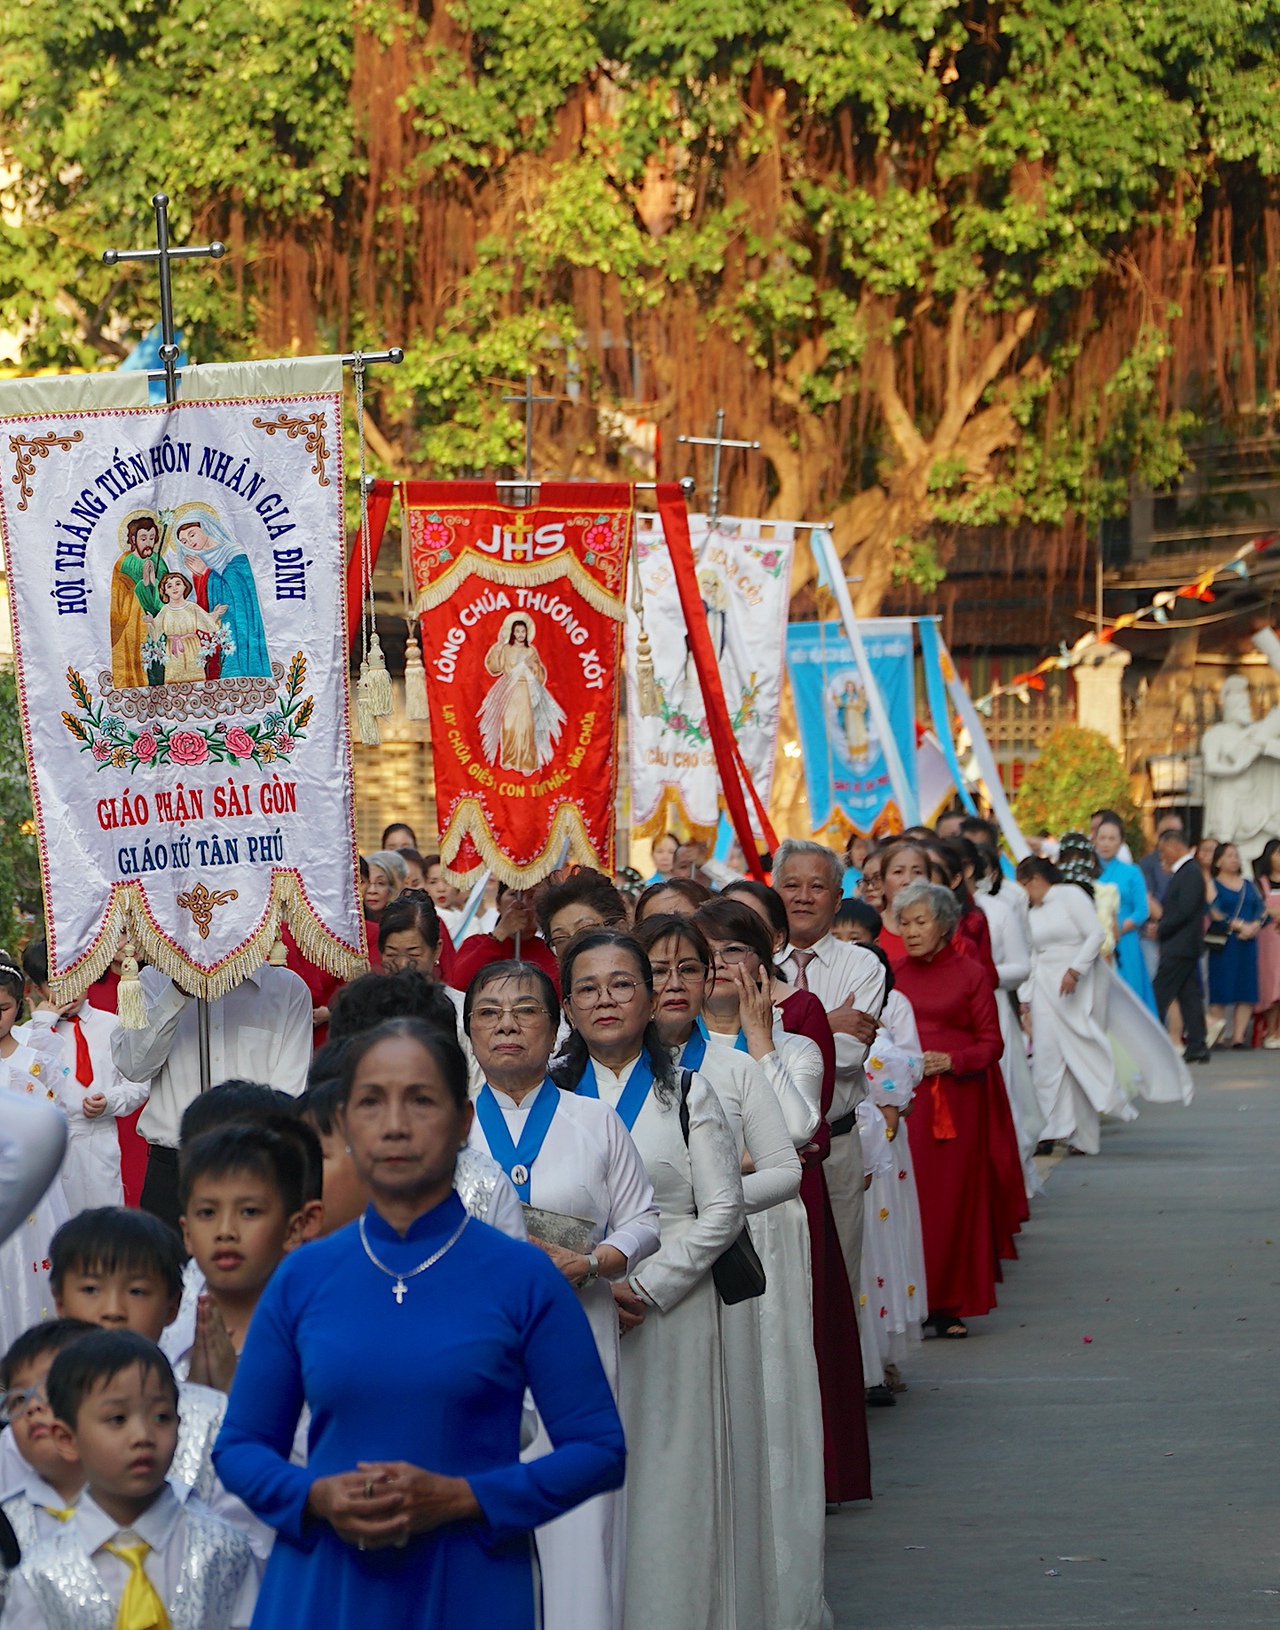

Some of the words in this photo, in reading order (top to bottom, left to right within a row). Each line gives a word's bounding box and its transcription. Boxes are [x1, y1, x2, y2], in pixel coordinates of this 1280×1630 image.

[94, 446, 150, 502] TIẾN
[149, 434, 192, 478] HÔN
[197, 446, 266, 502] NHÂN
[54, 488, 109, 574] THĂNG
[255, 493, 297, 541] GIA
[475, 523, 566, 562] JHS
[50, 578, 93, 616] HỘI
[272, 547, 314, 601] ĐÌNH
[432, 626, 467, 684] LÒNG
[459, 587, 512, 627] CHÚA
[516, 588, 590, 646] THƯƠNG
[578, 648, 608, 690] XÓT
[447, 729, 472, 766] CHÚA
[498, 782, 525, 798] CON
[578, 711, 597, 746] CHÚA
[96, 787, 149, 831] GIÁO
[154, 782, 204, 828] PHẬN
[213, 777, 253, 818] SÀI
[259, 773, 297, 814] GÒN
[118, 838, 168, 875] GIÁO
[171, 834, 192, 868] XỨ
[195, 834, 239, 866] TÂN
[246, 827, 284, 863] PHÚ
